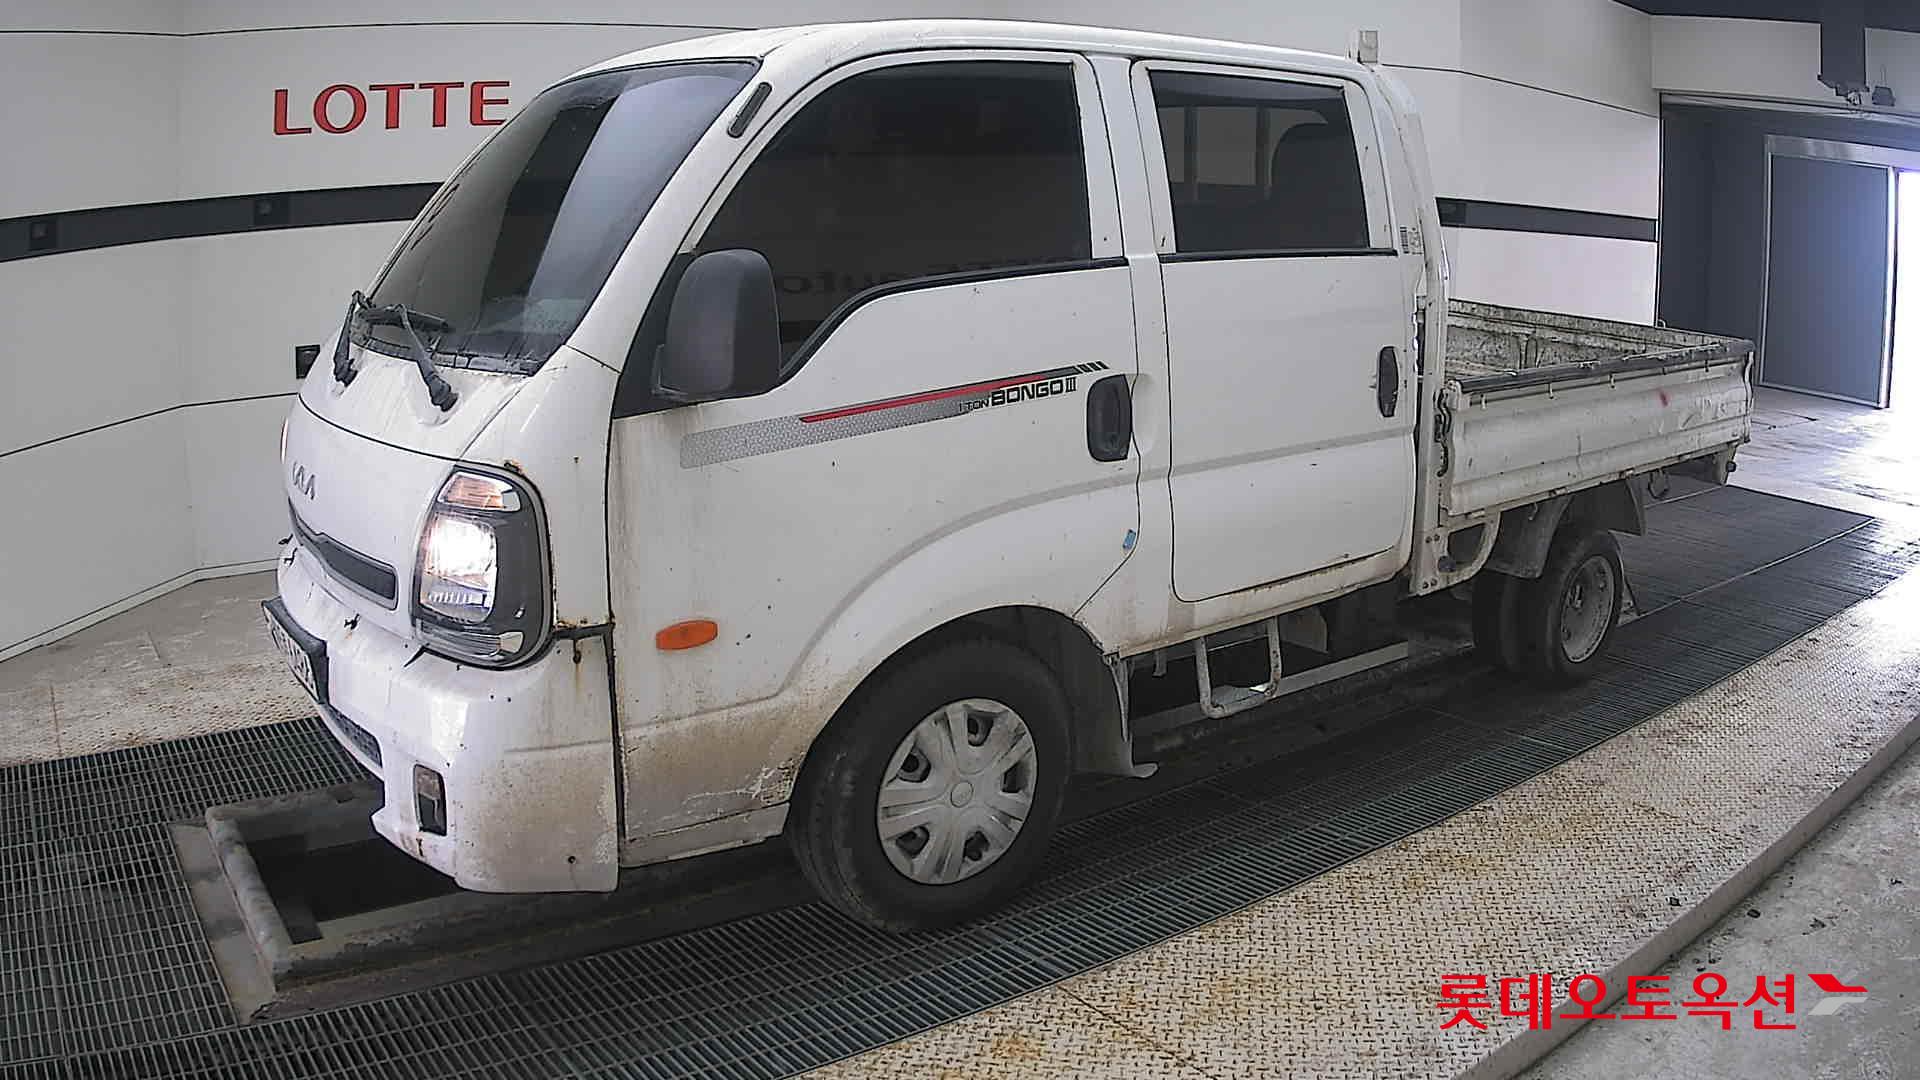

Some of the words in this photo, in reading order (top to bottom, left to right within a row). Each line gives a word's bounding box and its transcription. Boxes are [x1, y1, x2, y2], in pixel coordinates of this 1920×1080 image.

[274, 81, 509, 135] LOTTE
[966, 399, 989, 411] TON
[991, 380, 1064, 406] BONGO
